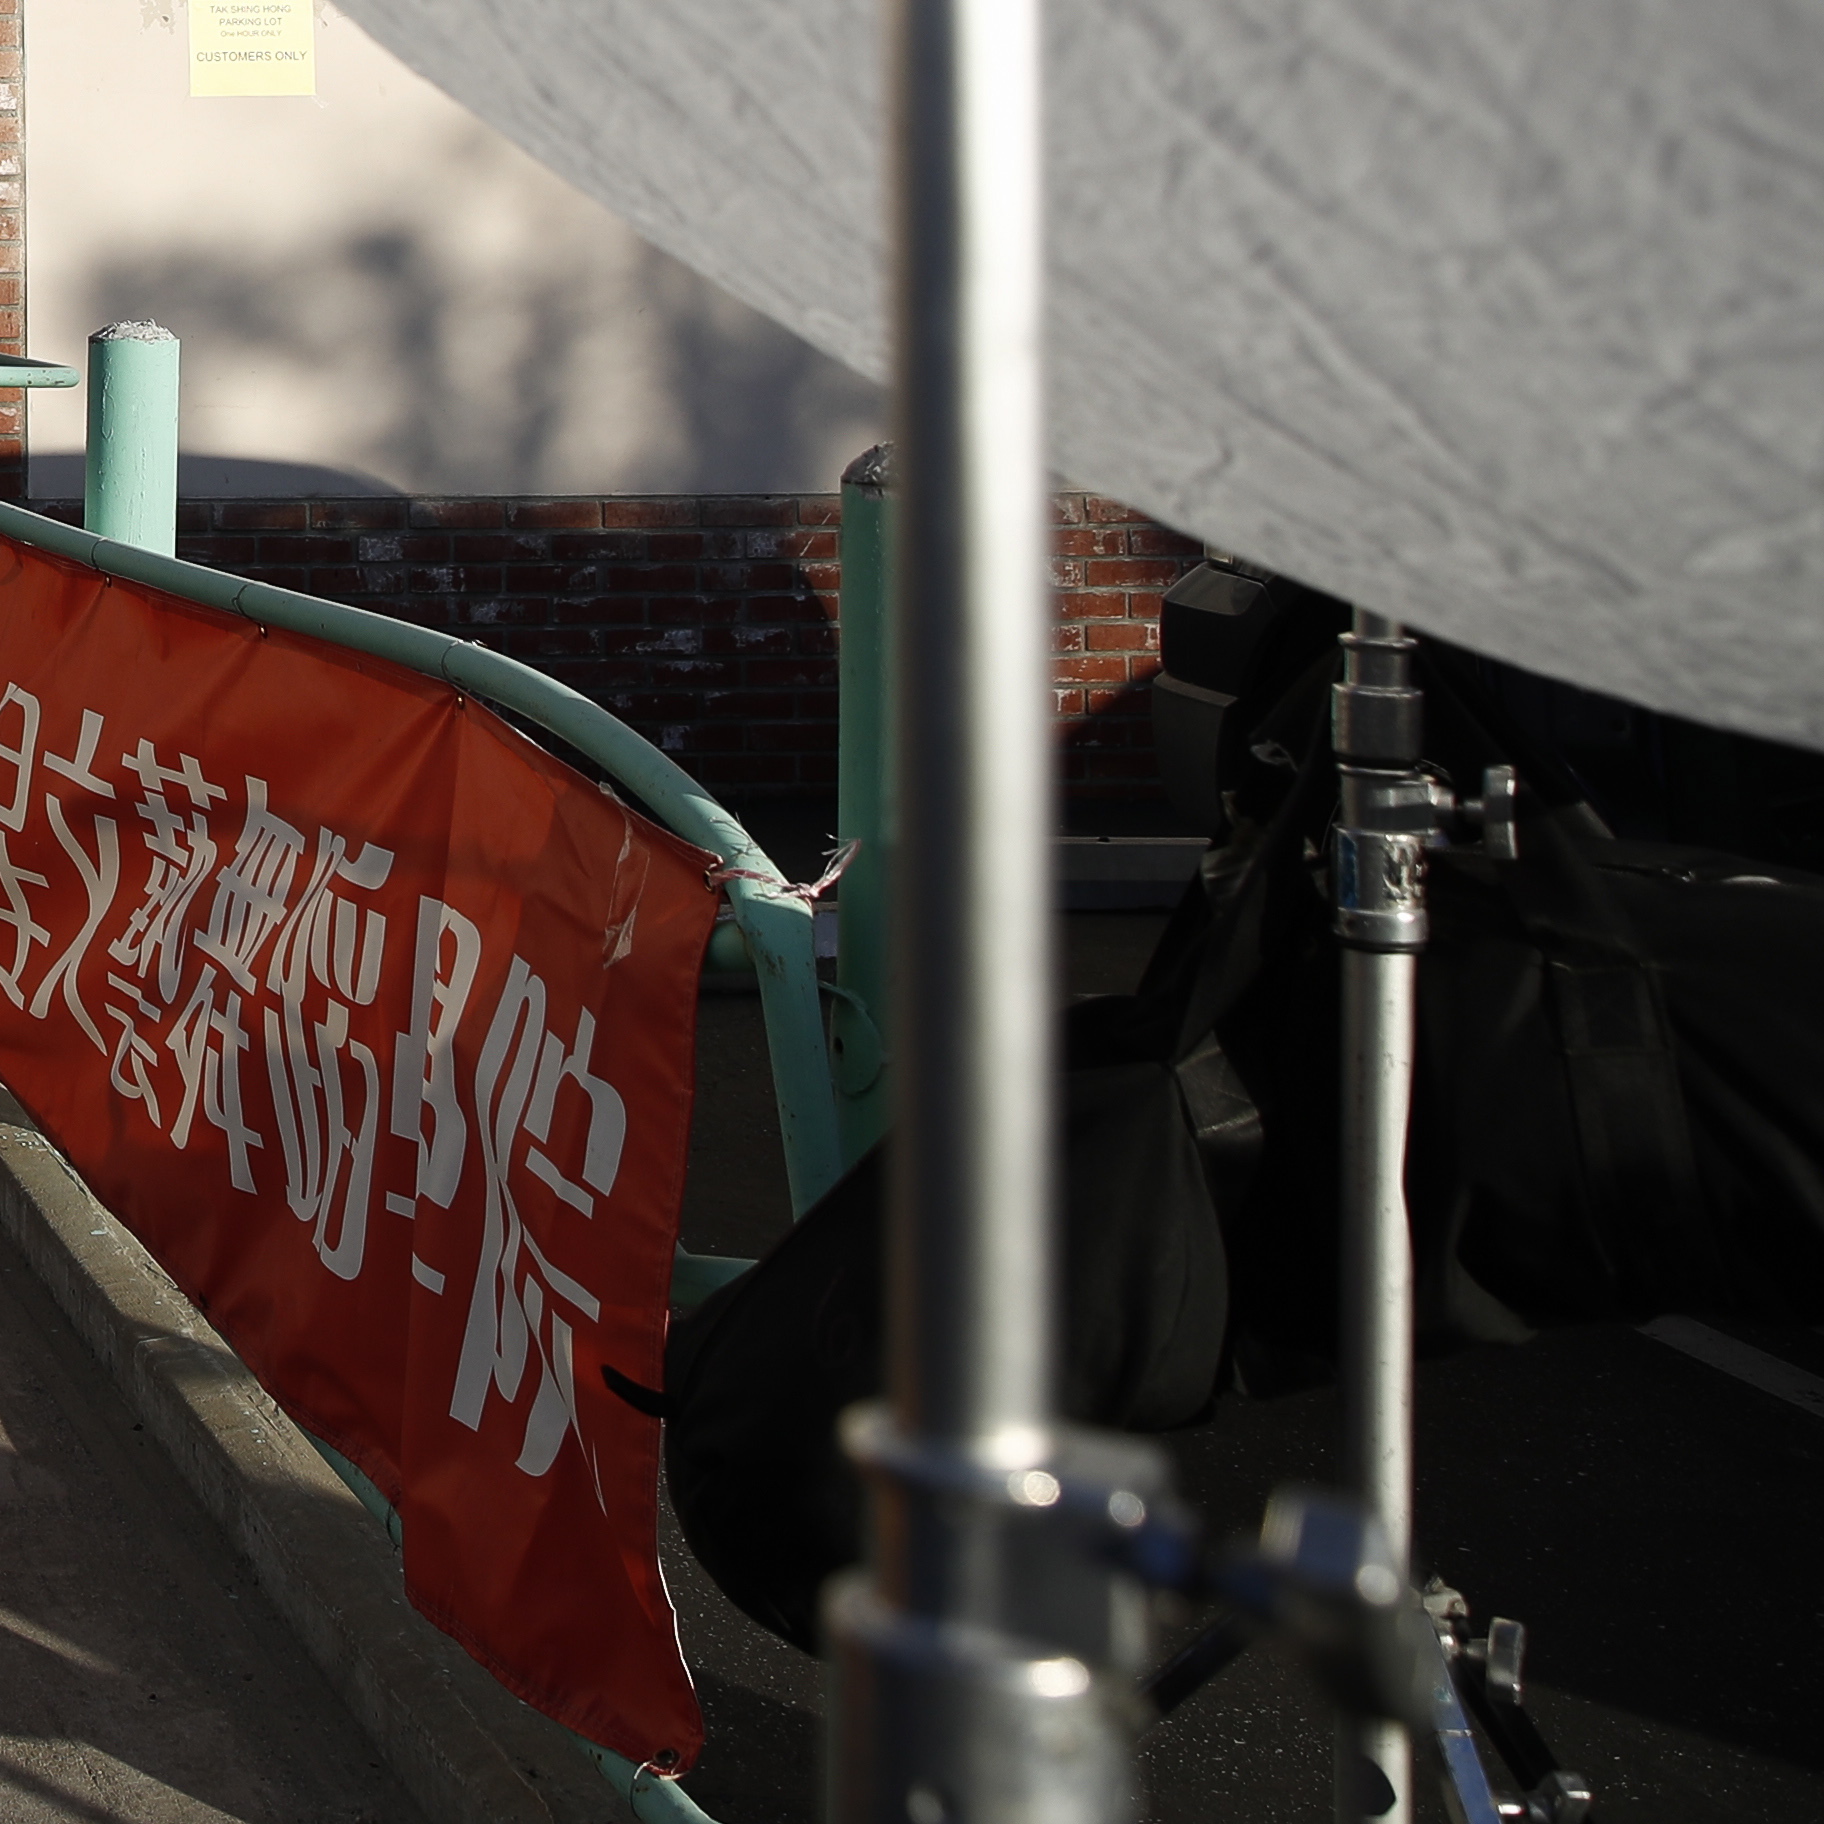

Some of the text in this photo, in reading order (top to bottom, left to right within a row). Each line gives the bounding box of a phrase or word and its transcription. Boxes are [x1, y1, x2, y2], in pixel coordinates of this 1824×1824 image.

[210, 4, 292, 14] TAK SHING HONG
[218, 17, 283, 26] PARKING LOT
[260, 29, 283, 37] ONLY
[196, 50, 308, 62] CUSTOMERS ONLY
